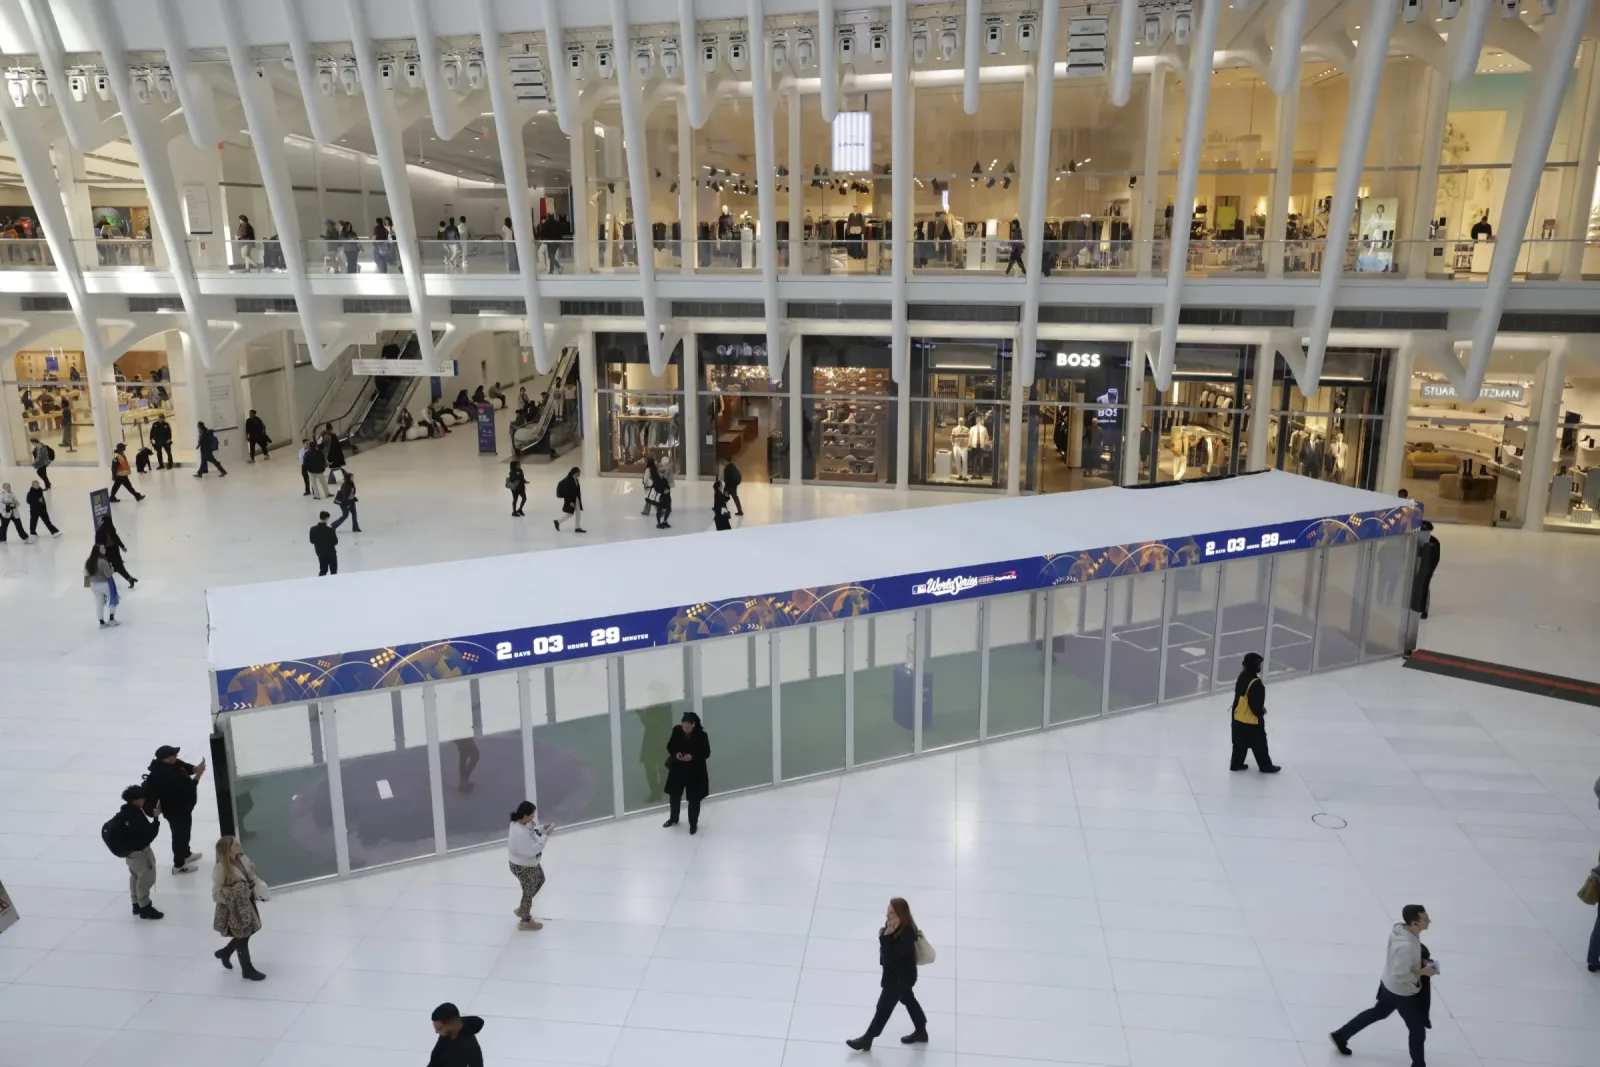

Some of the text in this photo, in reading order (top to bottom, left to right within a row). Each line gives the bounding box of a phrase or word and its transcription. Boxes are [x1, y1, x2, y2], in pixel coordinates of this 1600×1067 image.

[1056, 353, 1100, 367] BOSS
[1424, 386, 1519, 398] STUAR ITZMAN
[1205, 541, 1215, 556] 2
[1227, 537, 1246, 552] 03
[496, 641, 512, 660] 2
[533, 634, 563, 655] 03
[567, 642, 589, 650] HOURS
[591, 626, 620, 647] 29
[622, 633, 649, 642] MINUTES
